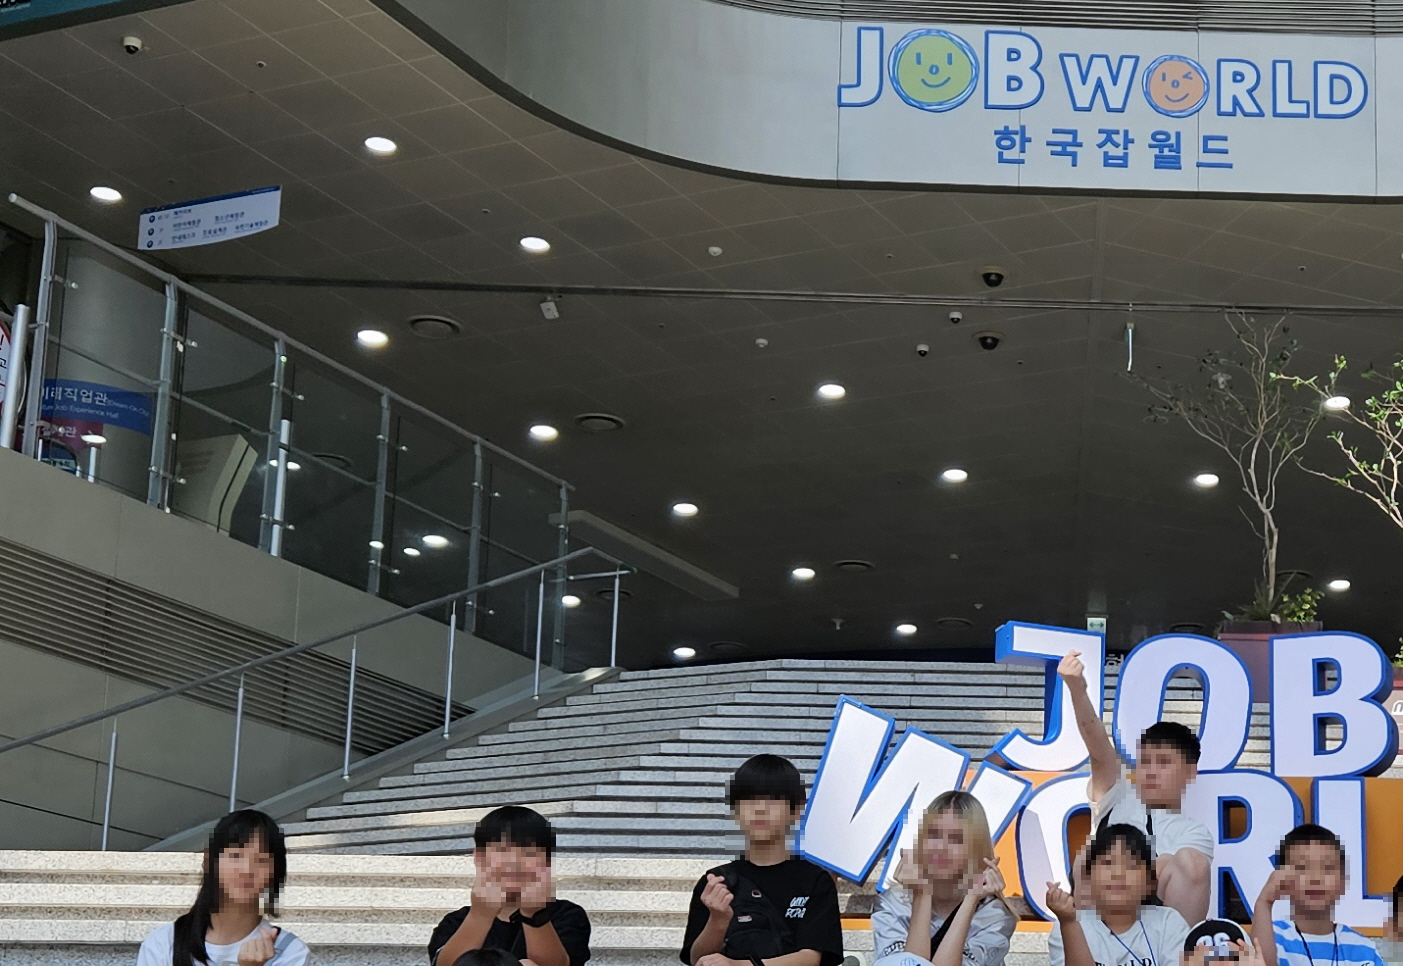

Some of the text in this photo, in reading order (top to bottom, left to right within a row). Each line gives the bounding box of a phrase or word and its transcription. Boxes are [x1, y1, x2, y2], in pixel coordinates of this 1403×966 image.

[837, 27, 1368, 119] JOB WORLD
[994, 124, 1234, 170] 한국잡월드
[995, 620, 1399, 777] JOB
